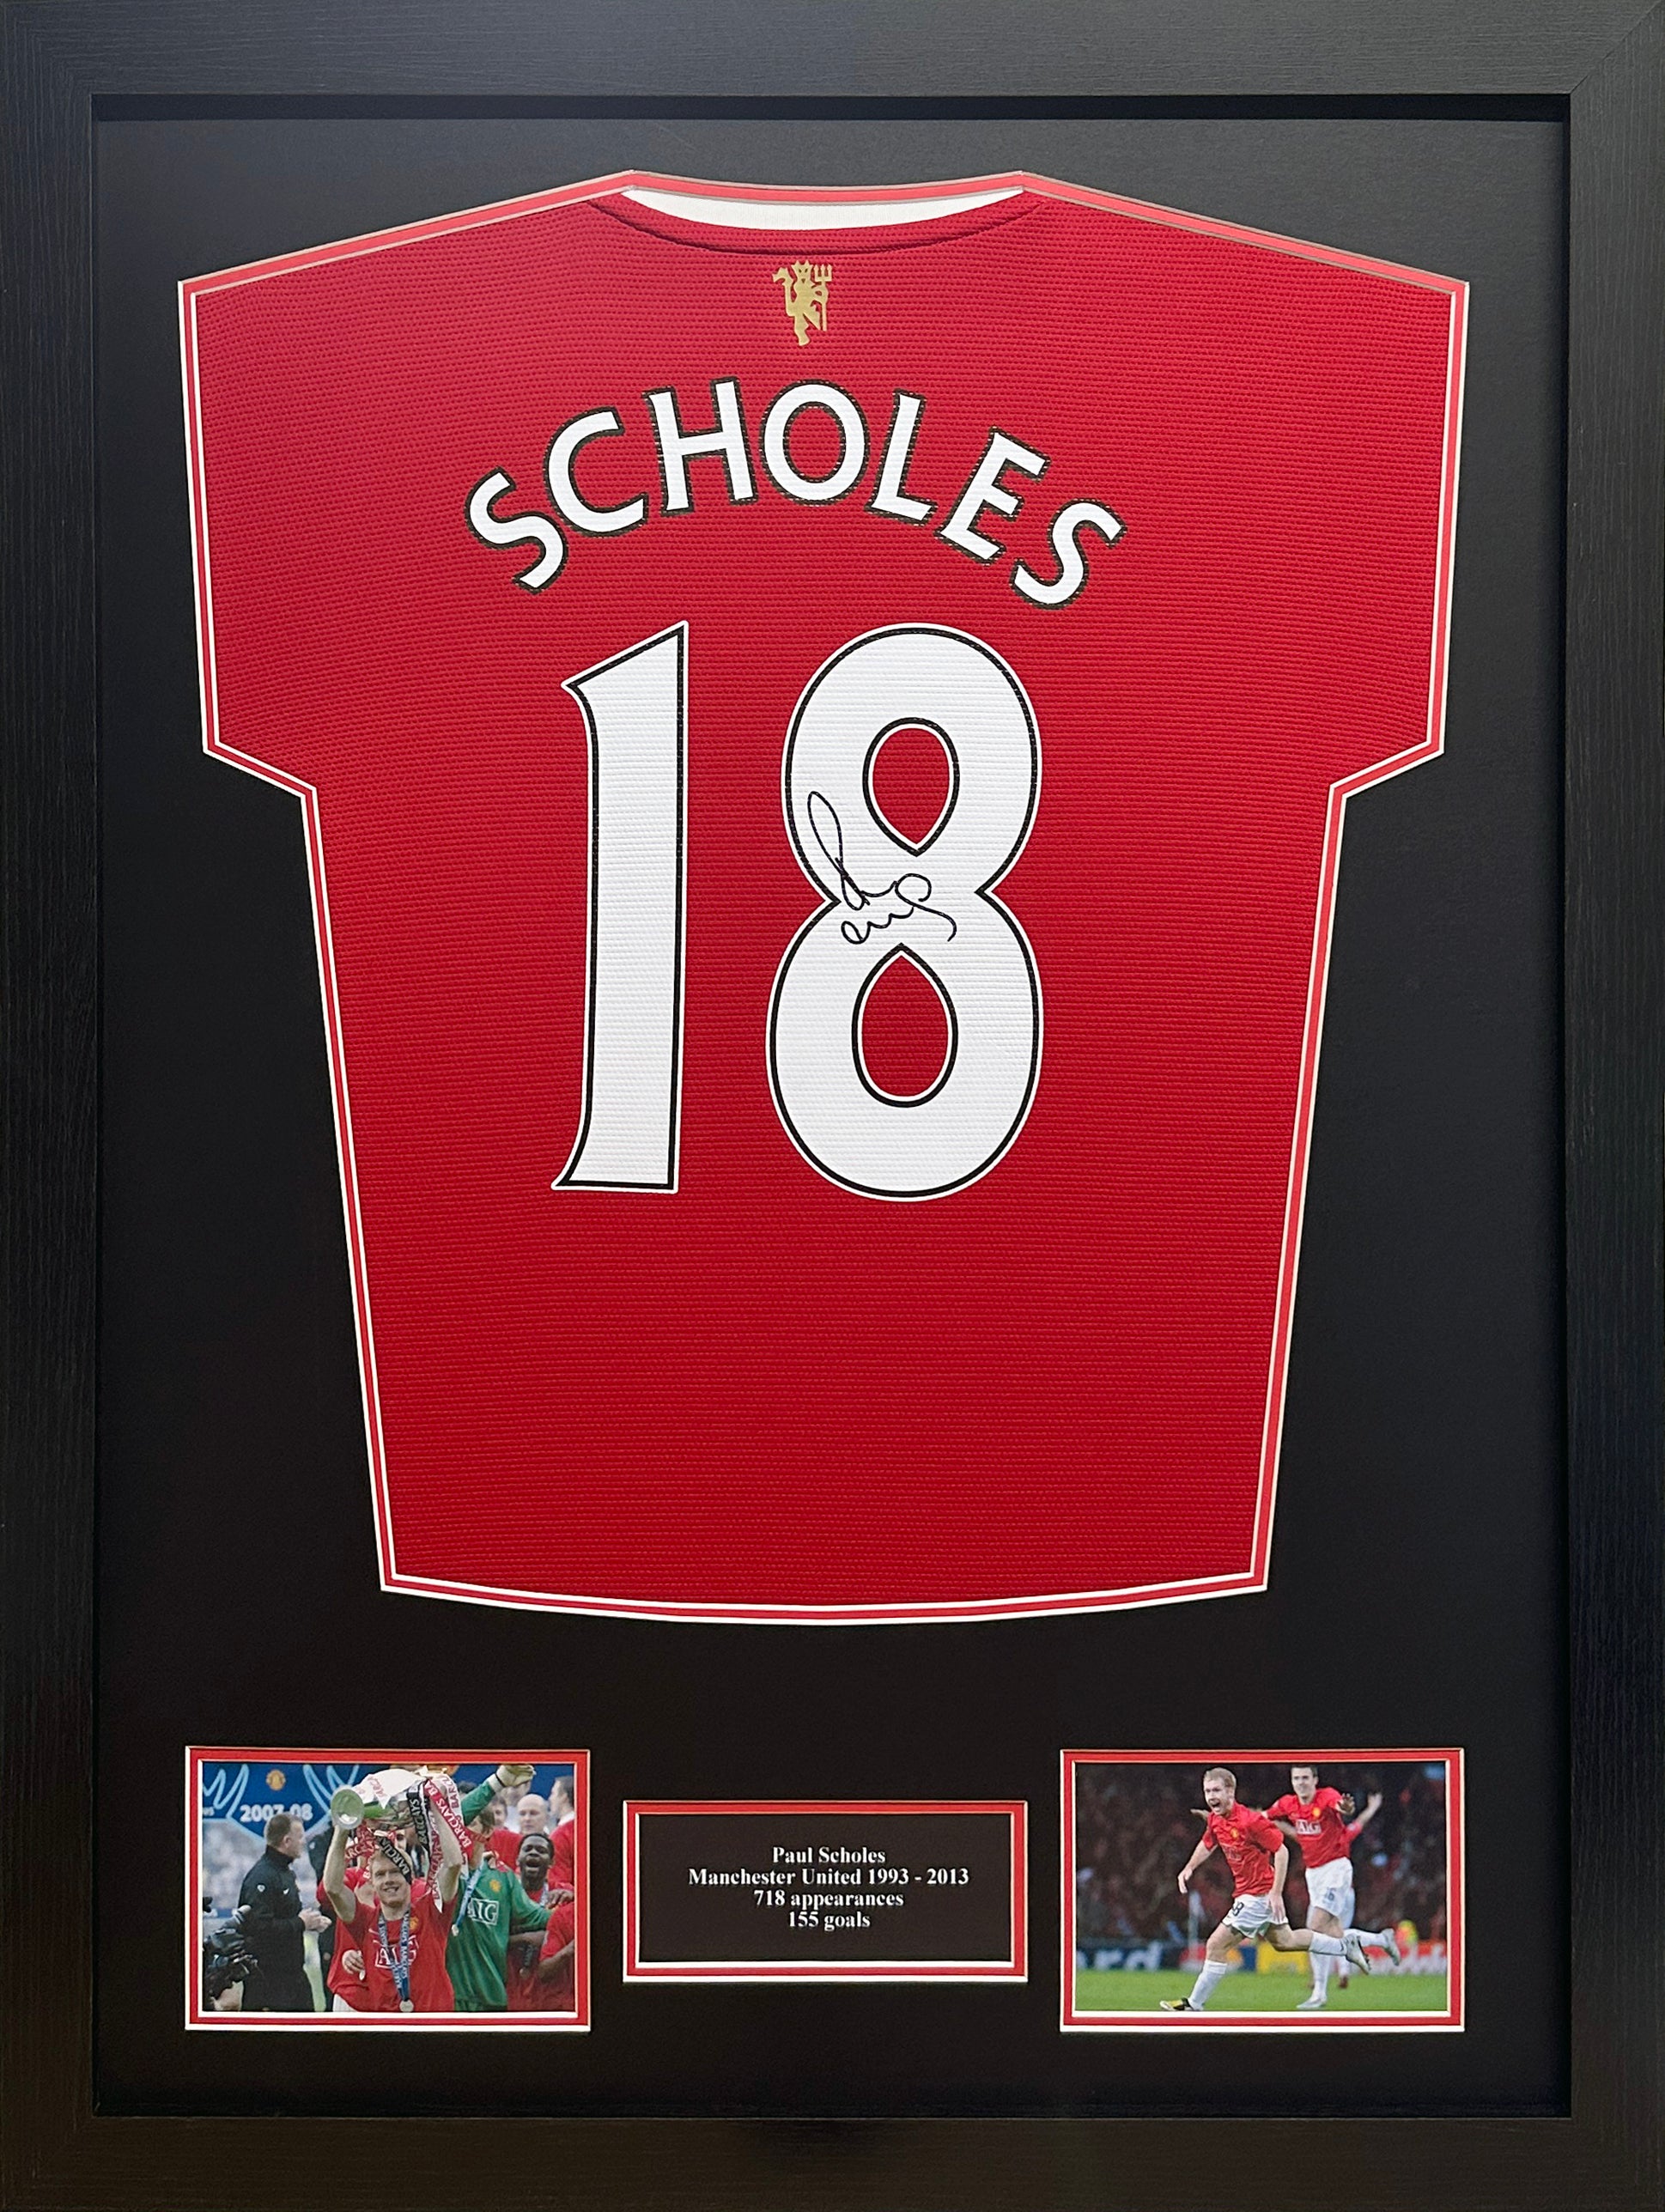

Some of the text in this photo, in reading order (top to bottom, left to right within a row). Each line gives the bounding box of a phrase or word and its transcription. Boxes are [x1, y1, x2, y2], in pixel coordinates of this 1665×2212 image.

[465, 380, 1127, 608] SCHOLES
[550, 620, 1044, 1202] 18
[435, 1797, 472, 1848] BARCLAYS
[773, 1846, 886, 1863] Paul Scholes
[689, 1868, 796, 1885] Manchester
[802, 1868, 861, 1885] United
[868, 1868, 909, 1885] 1993
[927, 1868, 969, 1885] 2013
[753, 1889, 904, 1911] 718 appearances
[788, 1911, 871, 1932] 155 goals
